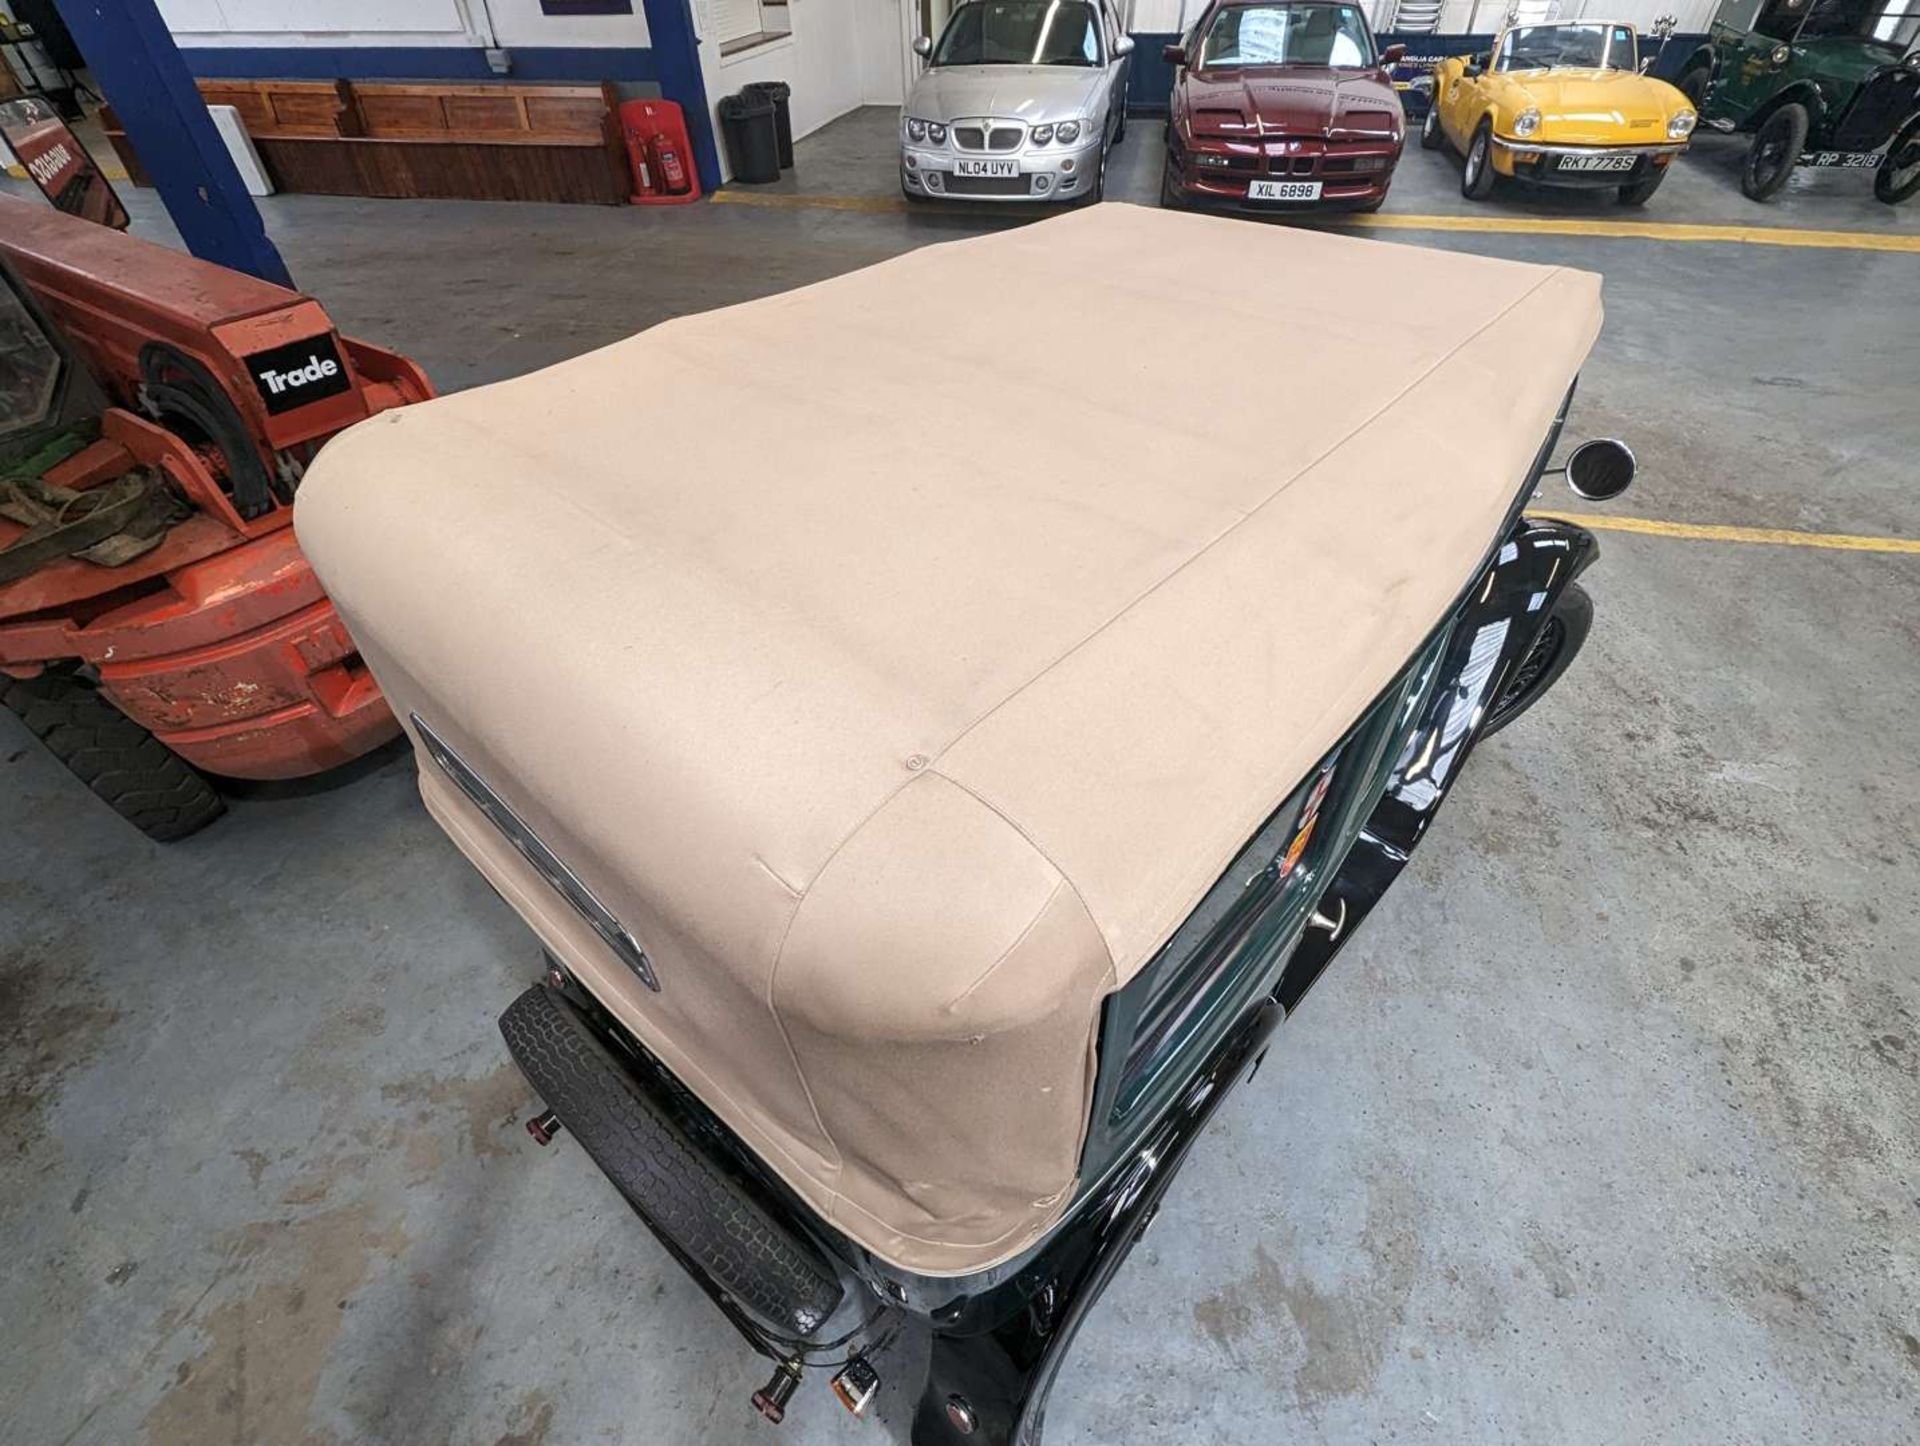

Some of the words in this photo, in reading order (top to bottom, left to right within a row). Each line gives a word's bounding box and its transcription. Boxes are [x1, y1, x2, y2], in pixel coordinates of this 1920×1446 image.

[1560, 156, 1592, 169] RKT
[1593, 156, 1634, 170] 778S
[1842, 153, 1879, 167] 3218
[958, 161, 987, 175] NL04
[991, 161, 1013, 175] UYV
[1256, 183, 1275, 197] XIL
[1280, 184, 1314, 198] 6898
[259, 355, 338, 394] Trade
